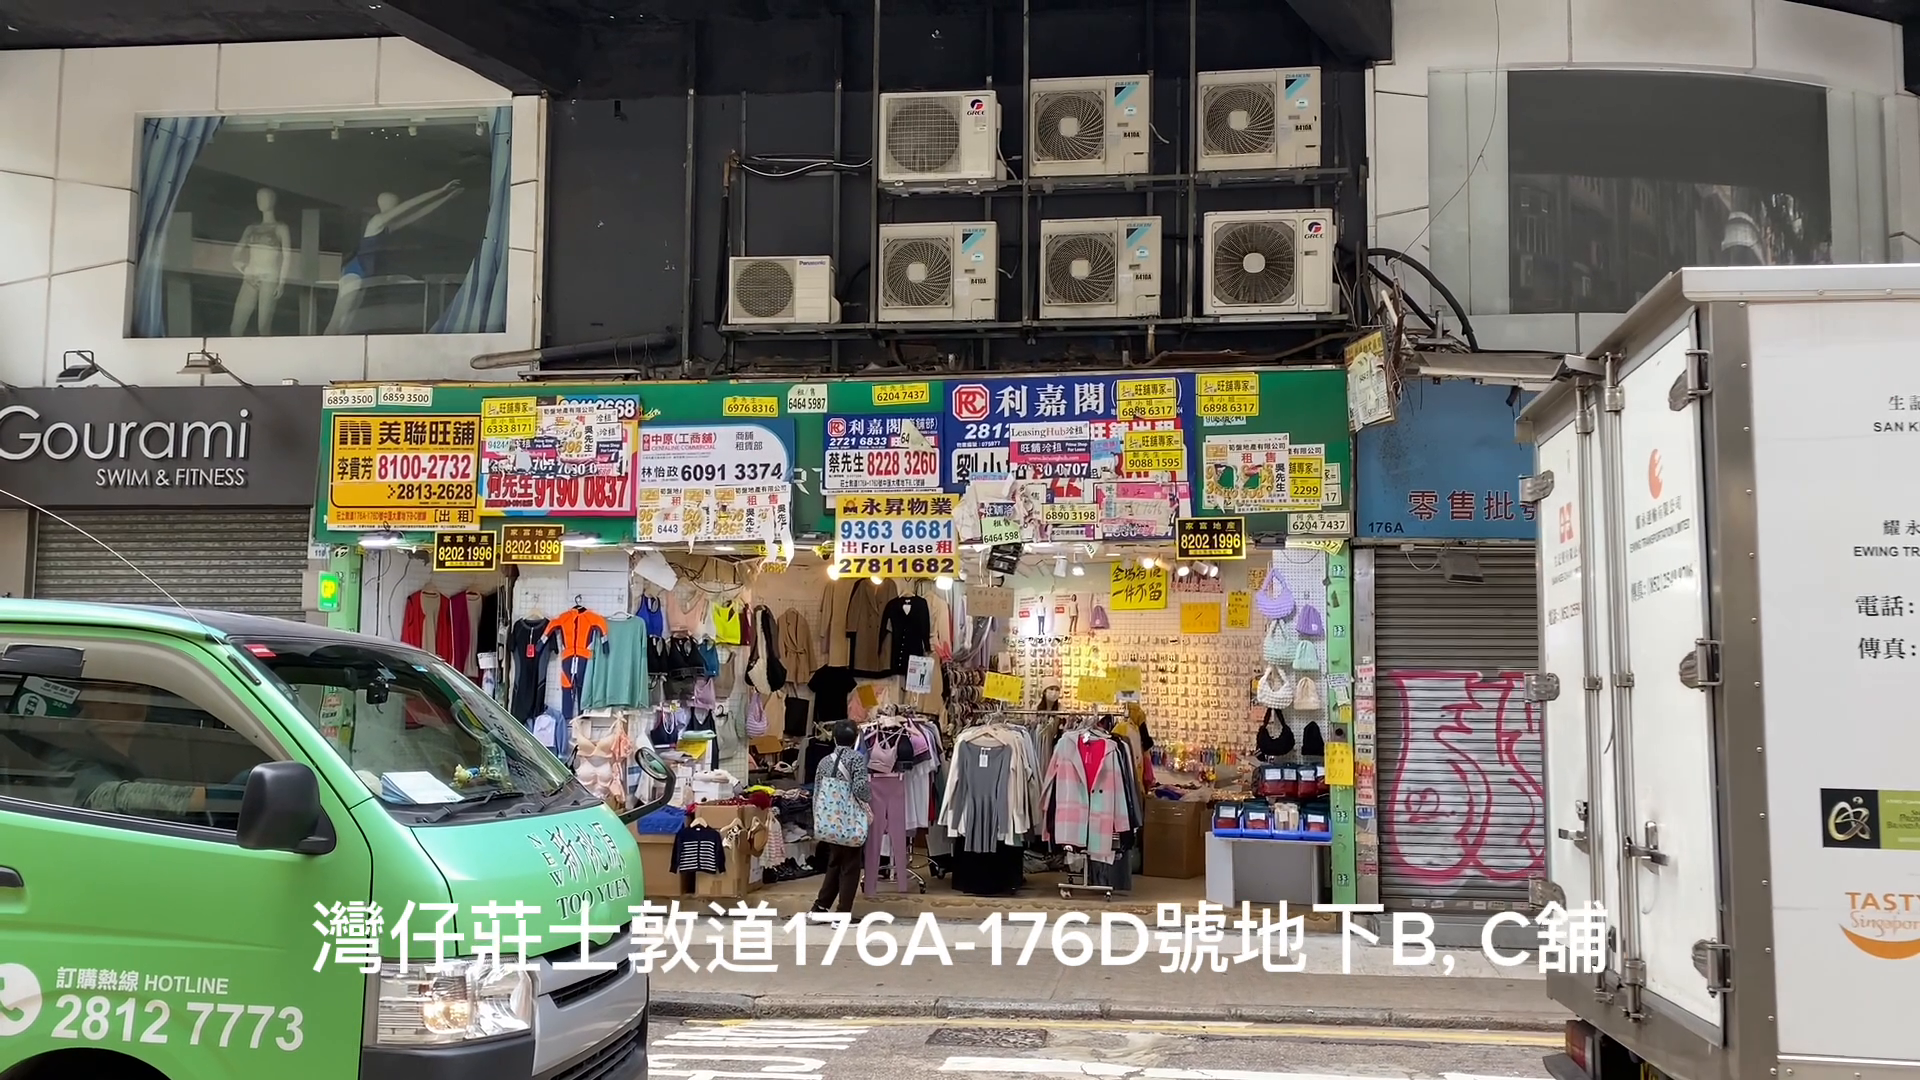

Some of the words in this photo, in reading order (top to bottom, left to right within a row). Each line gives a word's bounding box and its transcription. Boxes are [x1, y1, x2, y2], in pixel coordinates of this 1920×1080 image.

[327, 395, 349, 405] 6859
[351, 394, 373, 404] 3500
[383, 392, 404, 402] 6859
[407, 393, 429, 403] 3500
[877, 391, 900, 402] 6204
[902, 390, 925, 400] 7437
[995, 382, 1105, 418] 利嘉閣
[727, 404, 750, 413] 6976
[752, 404, 775, 413] 8316
[788, 398, 806, 410] 6464
[808, 398, 826, 410] 5987
[1148, 405, 1173, 416] 6317
[1203, 403, 1228, 413] 6898
[1230, 403, 1255, 412] 6317
[0, 405, 250, 460] Gourami
[487, 424, 508, 433] 6333
[510, 423, 532, 433] 8171
[1873, 421, 1904, 432] SAN
[1909, 422, 1920, 432] K
[829, 437, 857, 446] 2721
[859, 437, 887, 446] 6833
[378, 455, 471, 480] 8100-2732
[828, 451, 864, 473] 蔡先生
[867, 451, 900, 476] 8228
[904, 451, 937, 475] 3260
[1054, 463, 1088, 476] 0707
[1128, 459, 1153, 468] 9088
[1156, 458, 1180, 467] 1595
[96, 468, 149, 486] SWIM
[155, 469, 169, 486] &
[176, 468, 245, 486] FITNESS
[641, 466, 678, 478] 林怡政
[681, 464, 726, 482] 6091
[734, 463, 783, 480] 3374
[397, 483, 473, 500] 2813-2628
[535, 476, 579, 508] 9190
[584, 473, 628, 508] 0837
[1293, 485, 1319, 495] 2299
[1324, 492, 1337, 501] 17
[860, 497, 953, 516] 永昇物業
[1045, 511, 1069, 521] 6890
[1071, 511, 1096, 521] 3198
[657, 524, 678, 534] 6443
[841, 520, 893, 539] 9363
[901, 519, 952, 539] 6681
[1292, 521, 1318, 531] 6204
[1320, 520, 1346, 530] 7437
[1368, 522, 1404, 534] 176A
[983, 533, 1003, 544] 6464
[1180, 534, 1210, 549] 8202
[1212, 533, 1241, 549] 1996
[438, 546, 465, 561] 8202
[467, 546, 492, 561] 1996
[505, 540, 531, 554] 8202
[534, 540, 559, 554] 1996
[841, 541, 857, 554] 出
[861, 542, 885, 554] For
[890, 542, 933, 554] Lease
[935, 540, 953, 554] 租
[1853, 546, 1899, 557] EWING
[838, 557, 954, 574] 27811682
[1112, 582, 1163, 603] 一件不留
[1855, 595, 1914, 617] 電話:
[1858, 637, 1917, 660] 傳真:
[596, 876, 631, 903] YUEN
[56, 966, 139, 992] 訂購熱線
[144, 974, 229, 995] HOTLINE
[51, 994, 171, 1044] 2812
[187, 1001, 304, 1051] 7773
